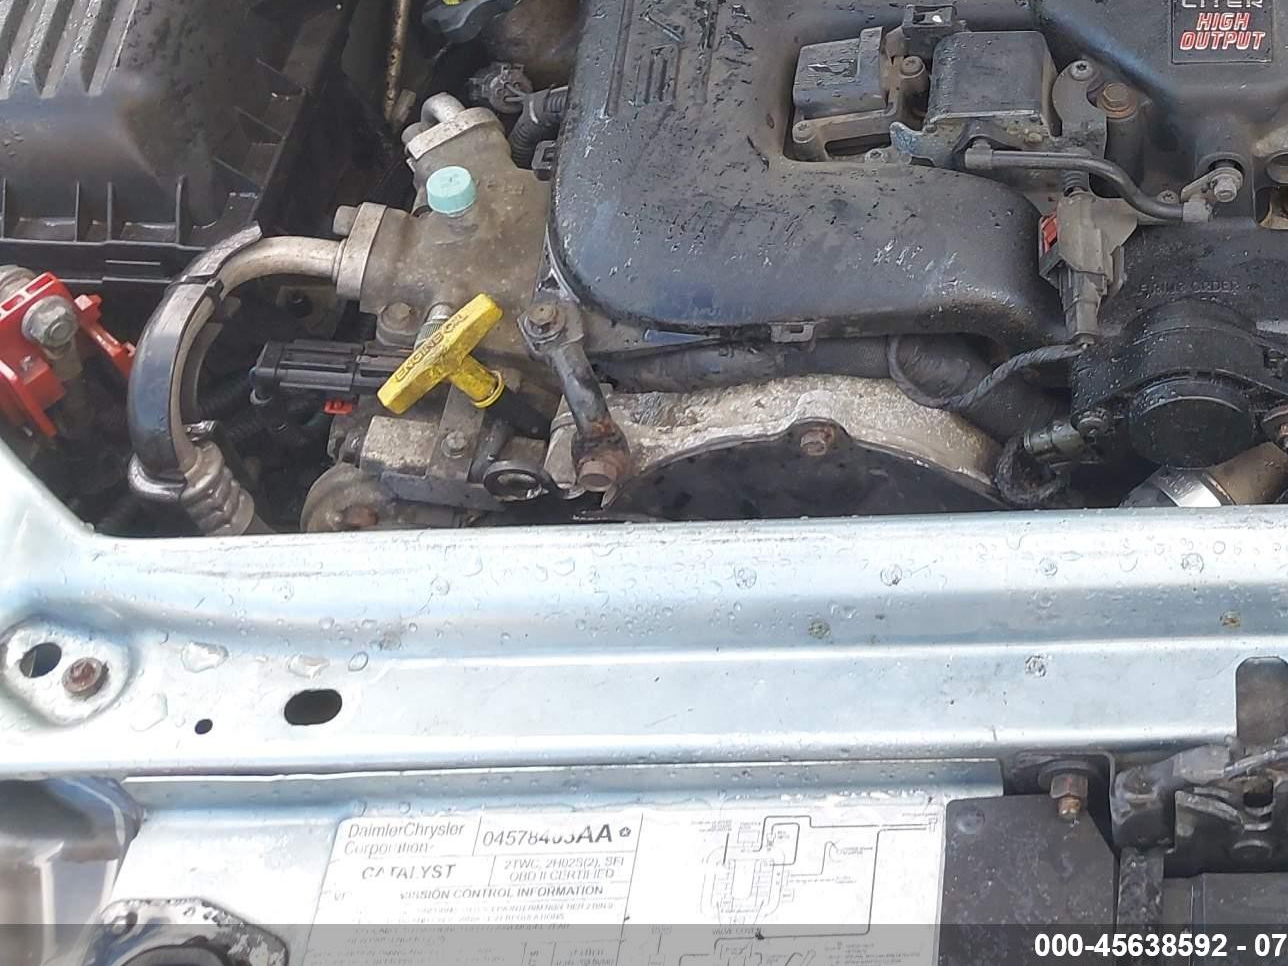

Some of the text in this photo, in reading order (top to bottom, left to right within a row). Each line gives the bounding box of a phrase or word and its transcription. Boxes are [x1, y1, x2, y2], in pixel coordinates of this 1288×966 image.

[1196, 12, 1251, 31] HIGH
[1179, 31, 1266, 50] OUTPUT
[395, 332, 444, 382] ENGINE
[348, 821, 465, 839] DaimlerChrysler
[509, 871, 536, 882] OBD
[550, 868, 615, 881] CERTIFIED
[453, 887, 513, 899] CONTROL
[517, 885, 604, 898] INFORMATION
